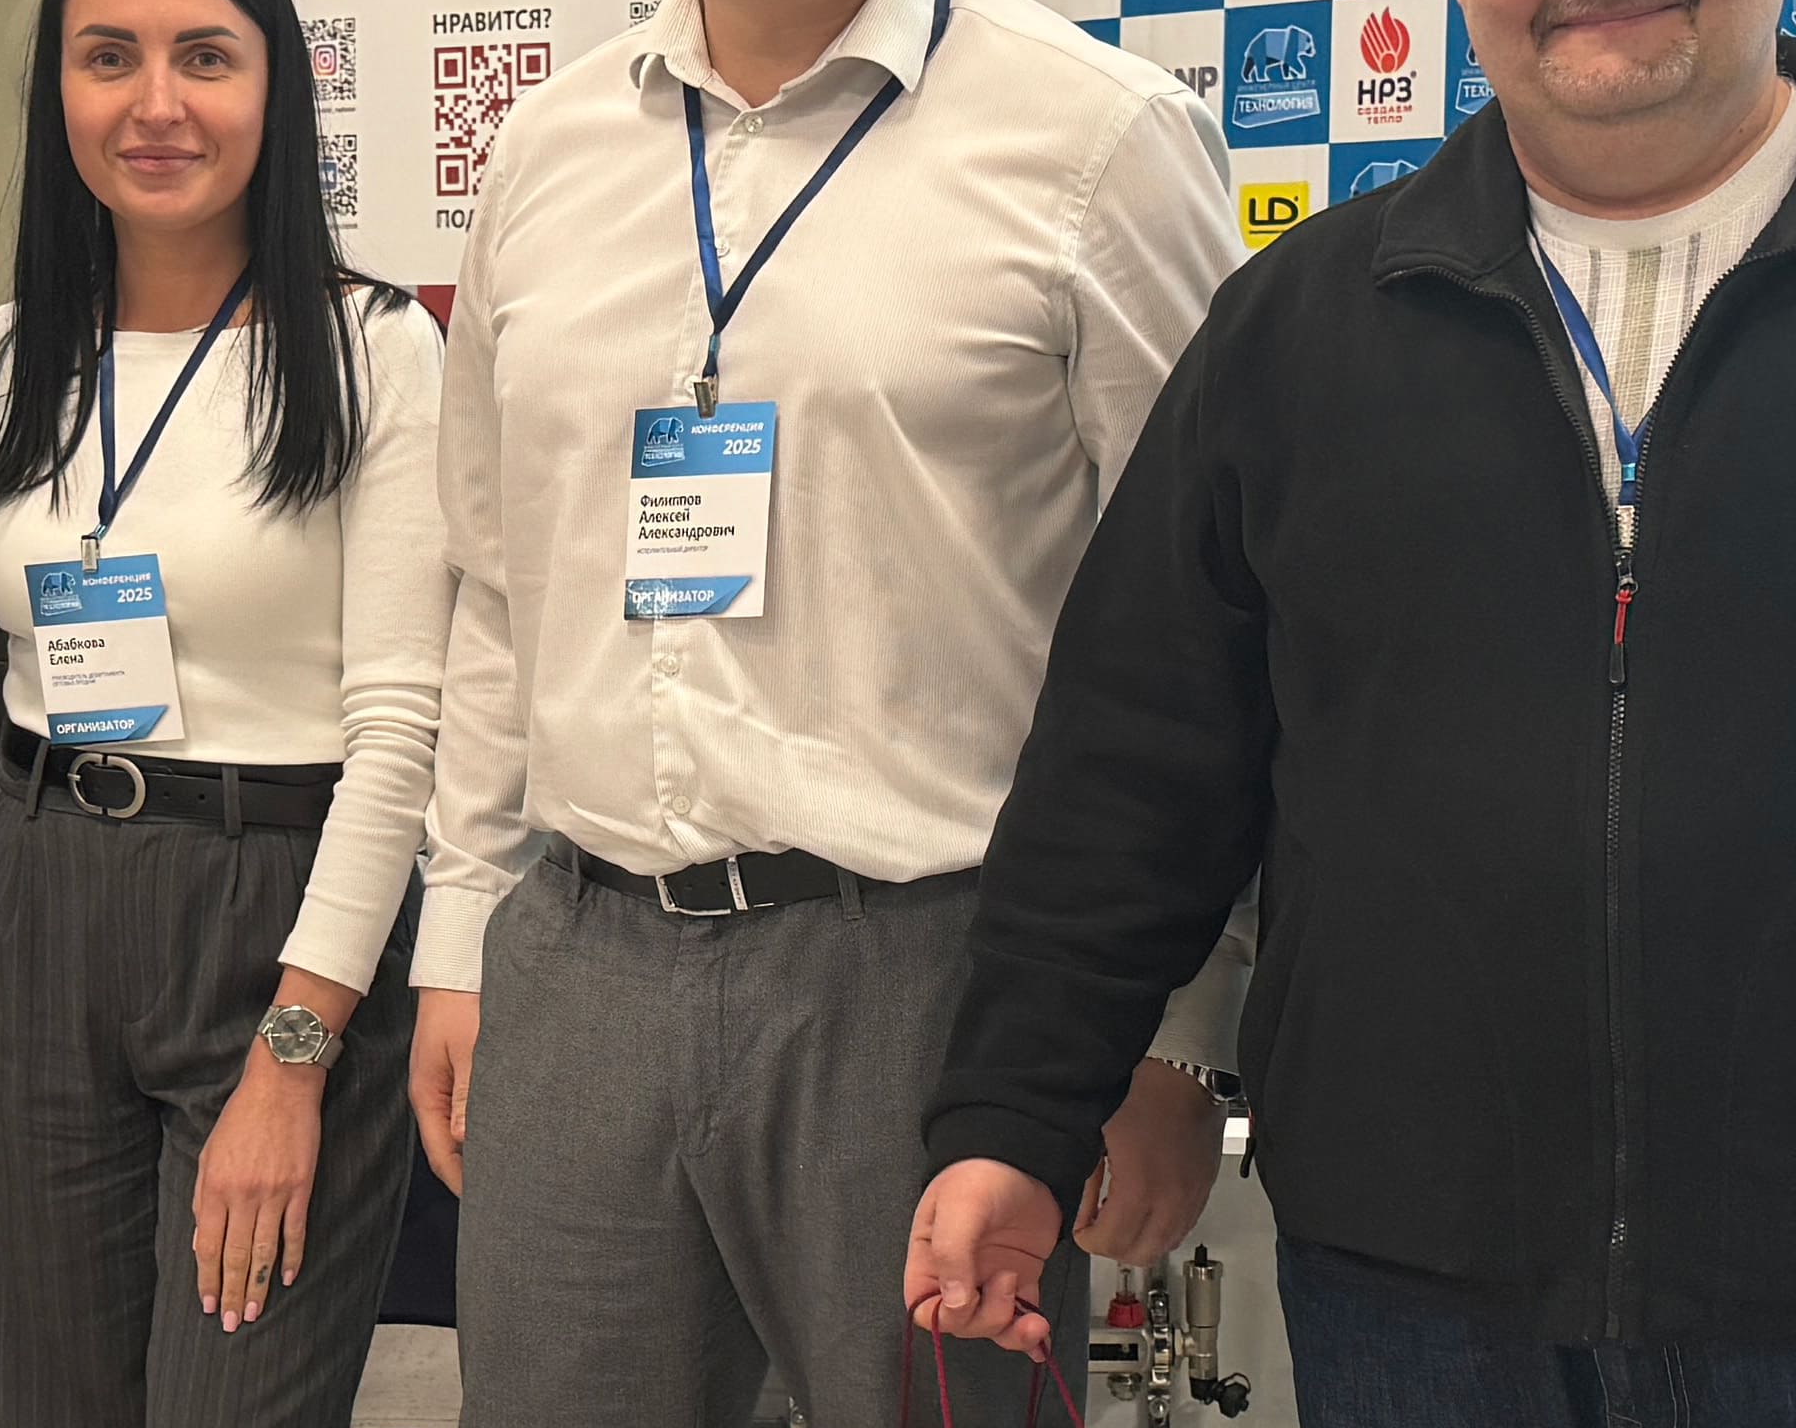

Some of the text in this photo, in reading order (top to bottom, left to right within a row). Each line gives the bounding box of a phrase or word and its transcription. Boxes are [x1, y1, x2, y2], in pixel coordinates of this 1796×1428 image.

[433, 8, 552, 34] НРАВИТСЯ?
[1249, 197, 1298, 226] LD
[722, 439, 762, 456] 2025
[640, 495, 702, 509] Филиппов
[639, 508, 691, 524] Алексей
[638, 525, 735, 542] Александрович
[117, 587, 153, 603] 2025
[48, 637, 105, 652] Абабкова
[50, 653, 84, 666] Елена
[56, 719, 135, 735] ОРГАНИЗАТОР
